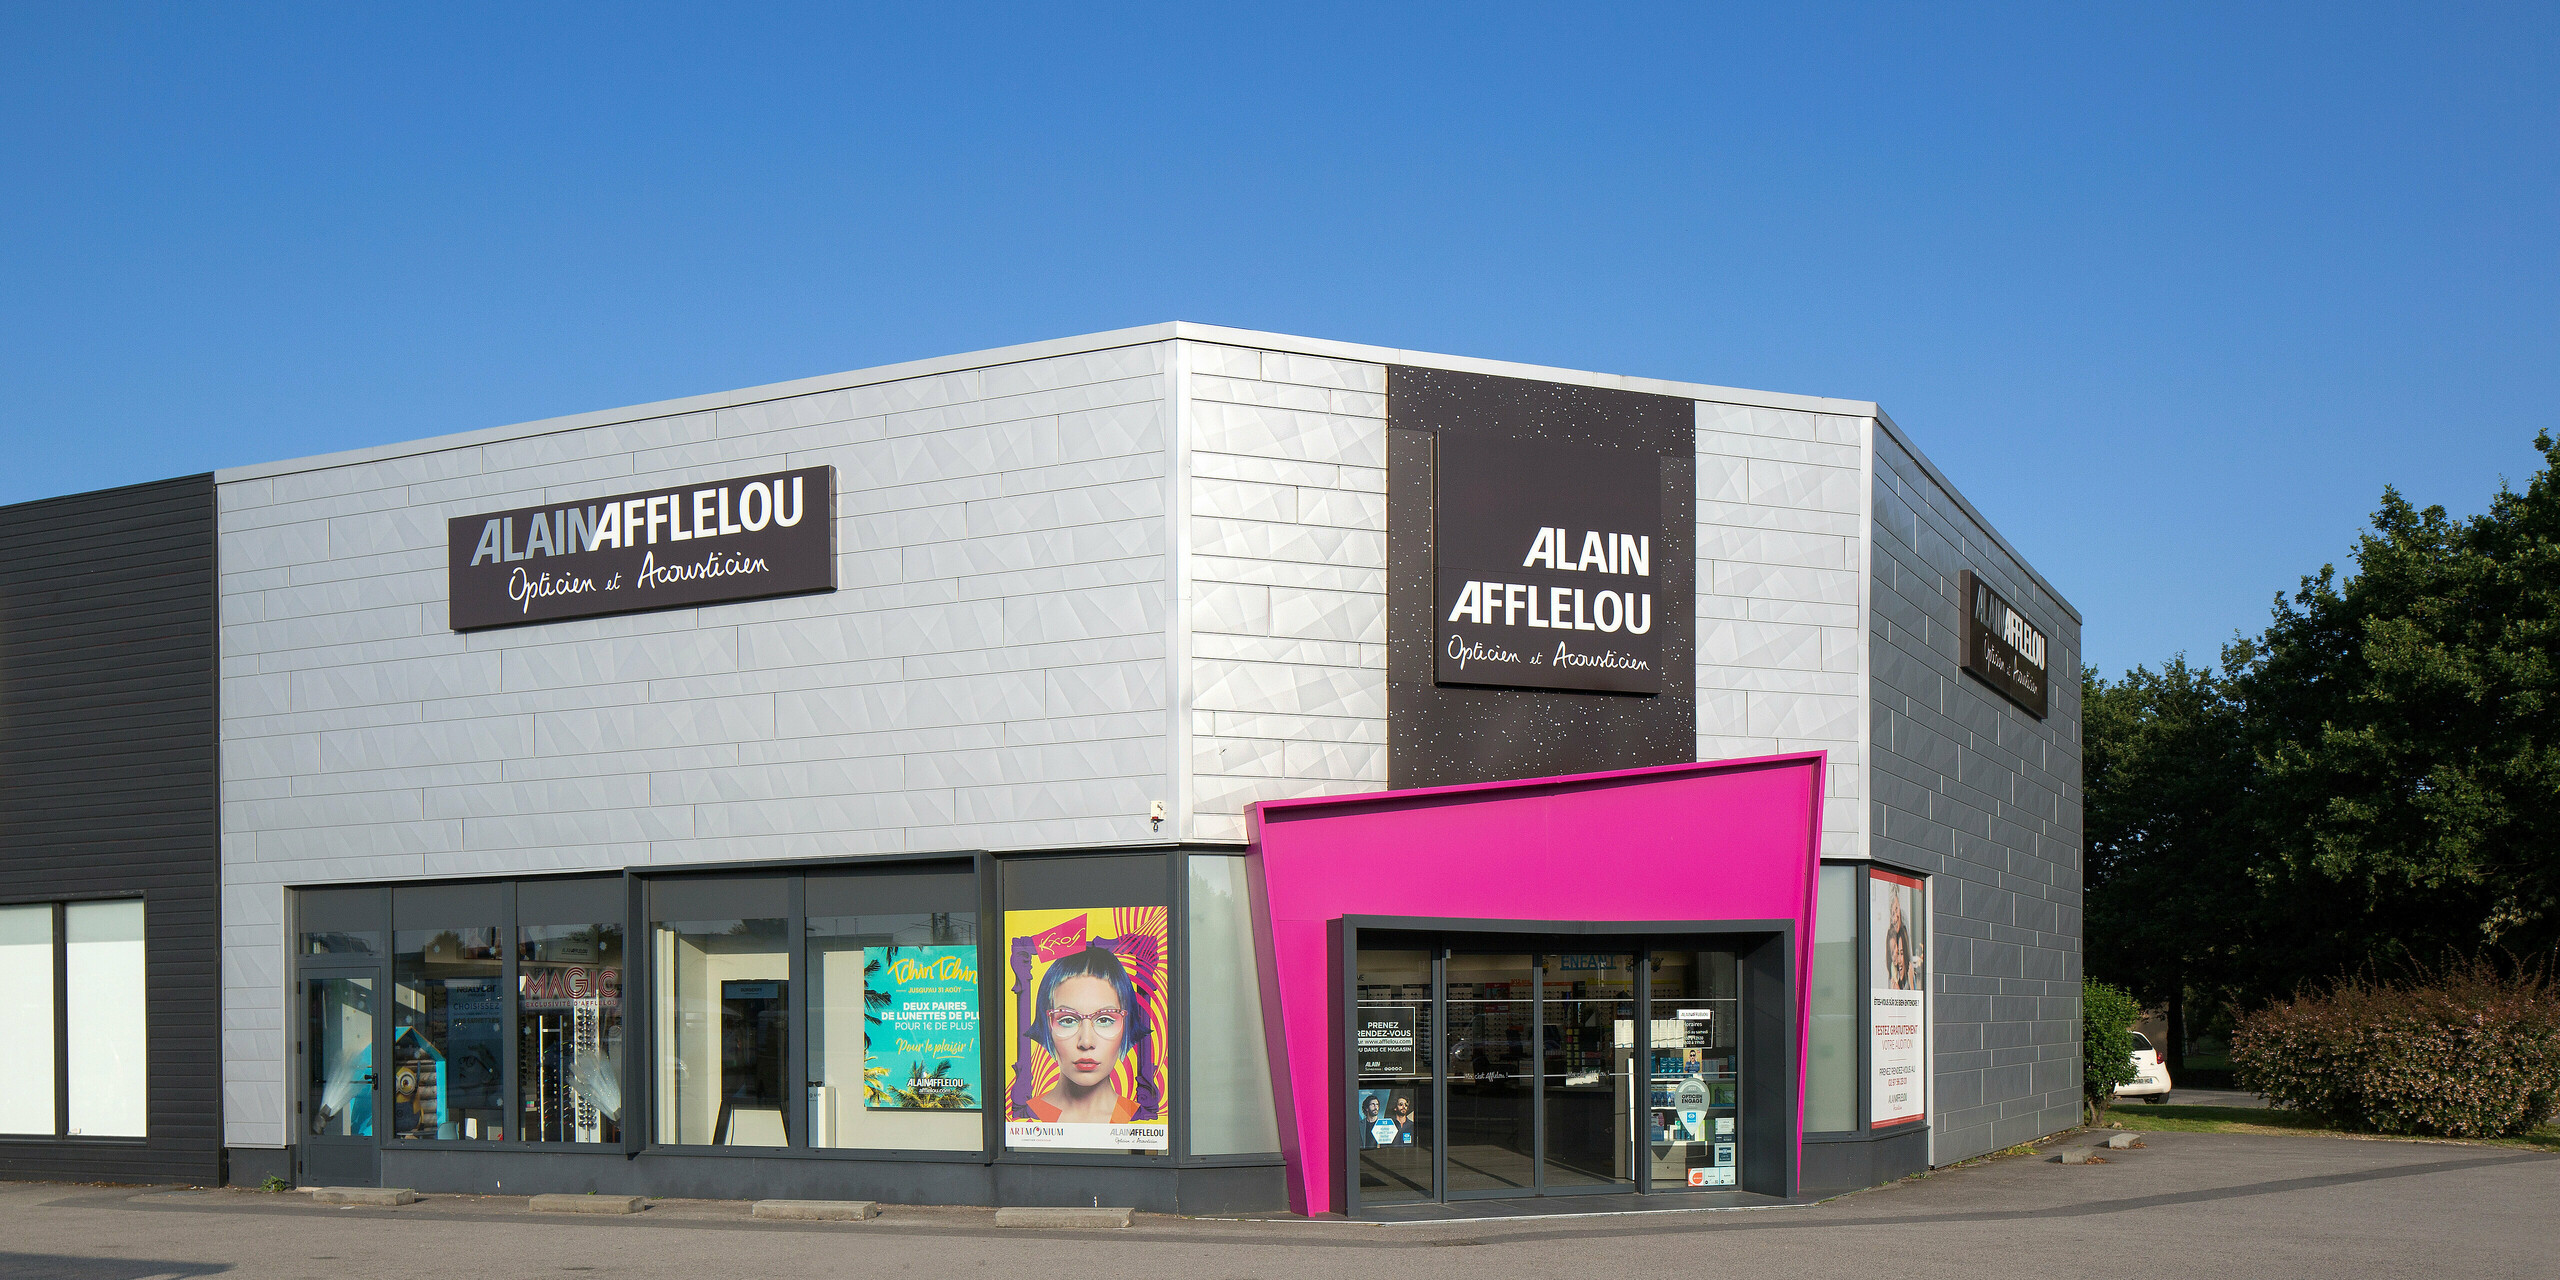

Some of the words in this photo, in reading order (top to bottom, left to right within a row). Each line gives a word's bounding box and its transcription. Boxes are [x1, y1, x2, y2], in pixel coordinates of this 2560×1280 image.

[1522, 526, 1650, 577] ALAIN
[508, 566, 596, 614] Opticien
[604, 571, 622, 590] et
[637, 550, 769, 589] Acousticien
[1447, 580, 1651, 635] AFFLELOU
[1447, 634, 1521, 670] Opticien
[1529, 652, 1543, 665] et
[1552, 641, 1650, 671] Acousticien
[887, 957, 934, 985] Tchin
[932, 956, 978, 985] Tchin
[525, 966, 617, 1000] MAGIC
[944, 985, 962, 993] AOÛT
[453, 1002, 500, 1011] CHOISISSEZ
[903, 1002, 930, 1011] DEUX
[931, 1001, 967, 1011] PAIRES
[881, 1011, 895, 1021] DE
[896, 1011, 947, 1021] LUNETTES
[948, 1011, 962, 1020] DE
[894, 1021, 921, 1031] POUR
[923, 1021, 933, 1031] 1€
[934, 1021, 949, 1031] DE
[1367, 1021, 1399, 1029] PRENEZ
[1875, 1025, 1890, 1035] TESTEZ
[1890, 1025, 1918, 1035] GRATUITEMENT
[895, 1037, 924, 1055] Pour
[924, 1038, 933, 1052] le
[932, 1038, 967, 1058] plaisir
[968, 1038, 975, 1052] !
[1009, 1126, 1064, 1138] ARTMONIUM
